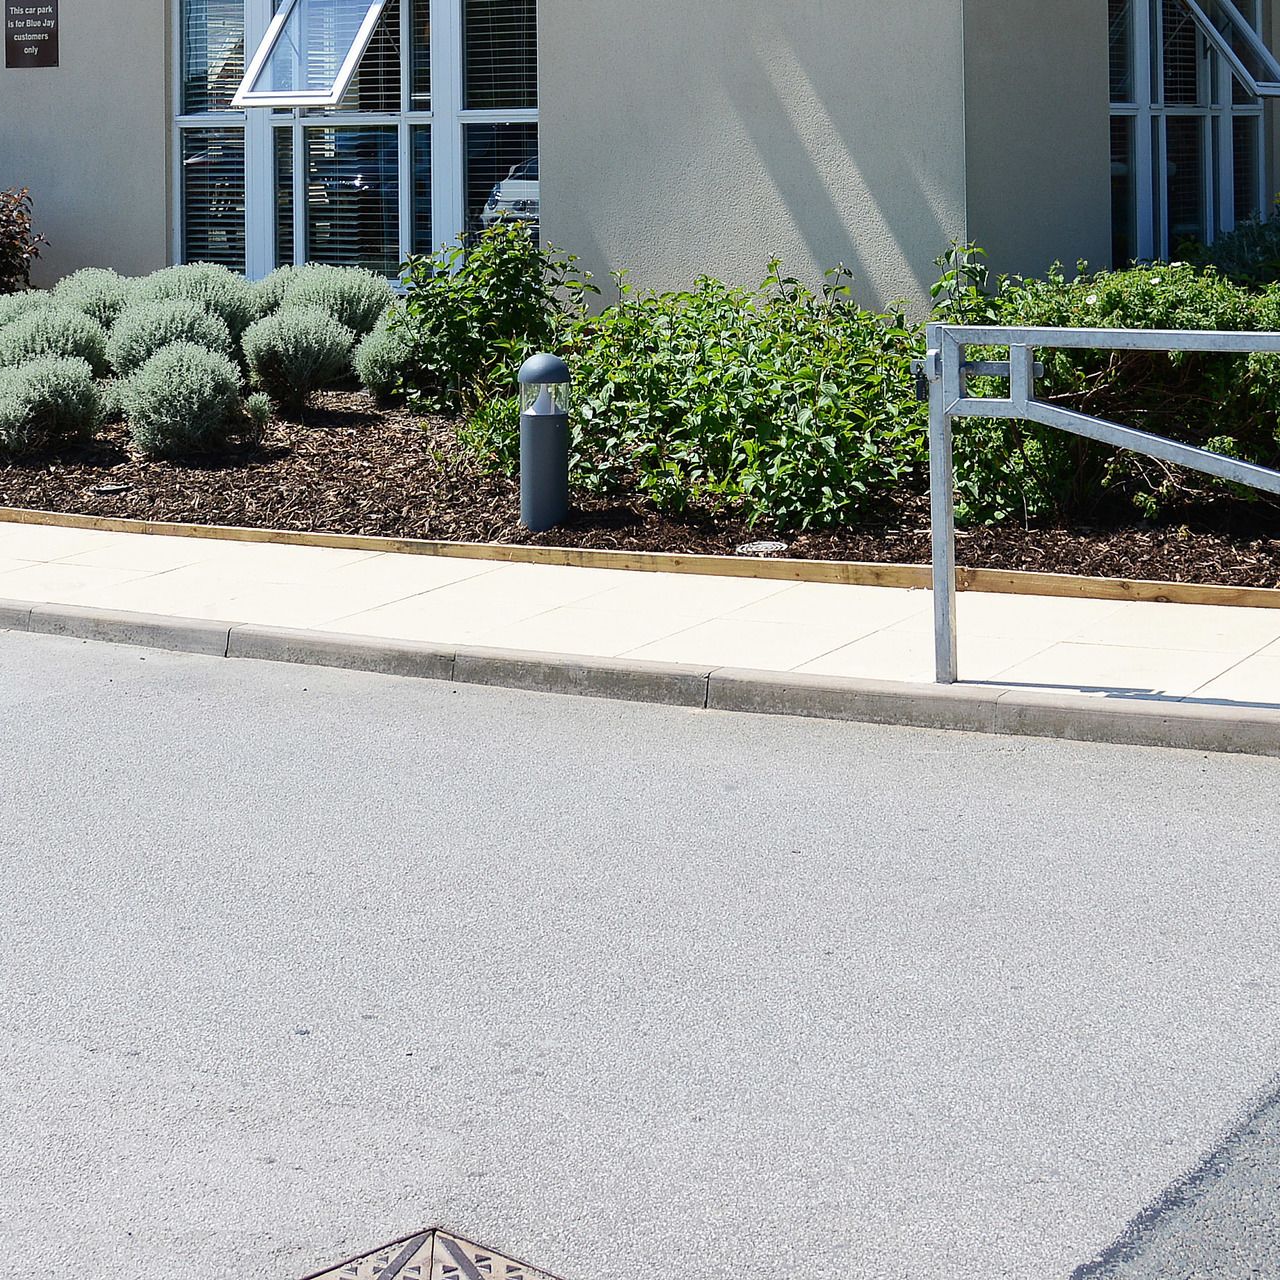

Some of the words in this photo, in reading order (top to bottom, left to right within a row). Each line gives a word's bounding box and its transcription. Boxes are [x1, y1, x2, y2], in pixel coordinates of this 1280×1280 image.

[9, 6, 24, 15] This
[37, 5, 53, 15] park
[7, 20, 14, 28] is
[15, 20, 25, 28] for
[26, 19, 41, 27] Blue
[42, 19, 55, 28] Jay
[13, 33, 49, 41] customers
[23, 46, 38, 55] only
